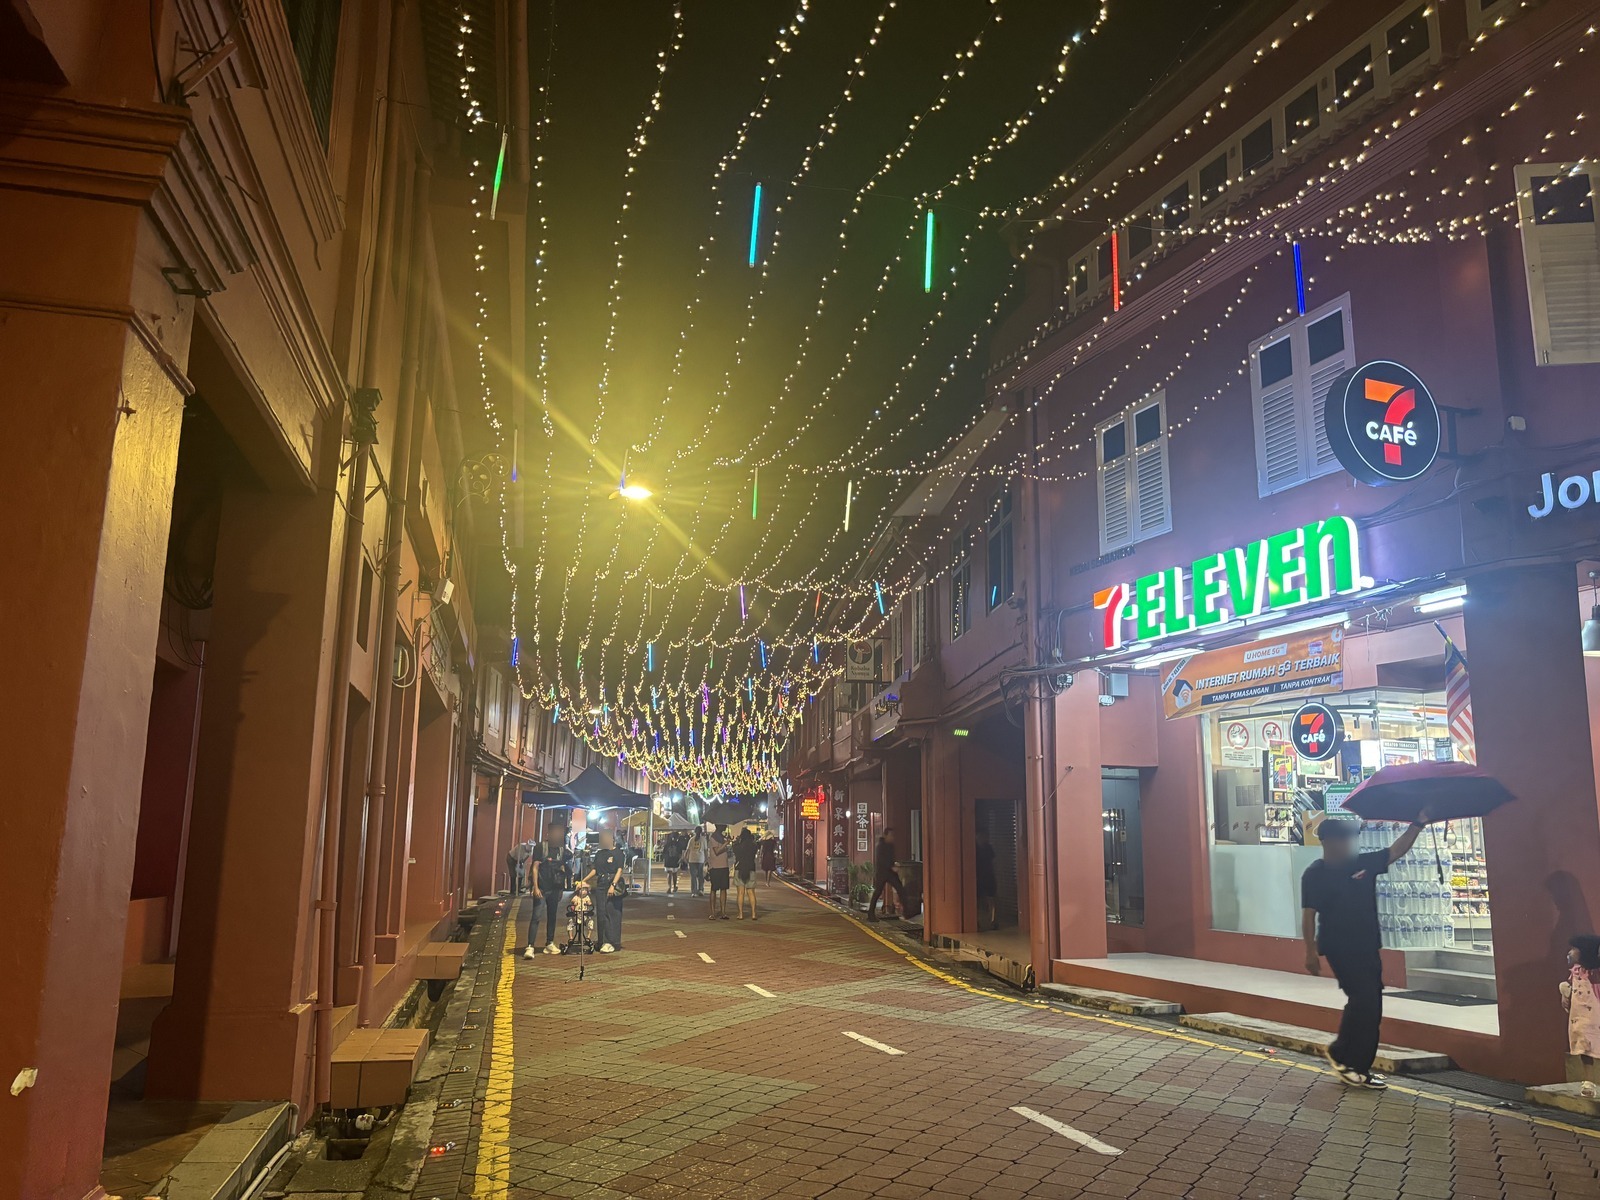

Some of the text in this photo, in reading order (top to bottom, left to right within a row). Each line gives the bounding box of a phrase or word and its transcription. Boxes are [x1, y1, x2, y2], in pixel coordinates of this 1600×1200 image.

[1364, 377, 1416, 466] 7
[1365, 420, 1418, 446] CAFé
[1251, 648, 1271, 659] HOME
[1195, 672, 1239, 691] INTERNET
[1239, 666, 1276, 683] RUMAH
[1277, 660, 1292, 677] 5G
[1294, 652, 1341, 673] TERBAIK
[1212, 675, 1331, 702] TANPA PEMASANGAN TANPA KONTRAK
[1300, 712, 1325, 753] 7
